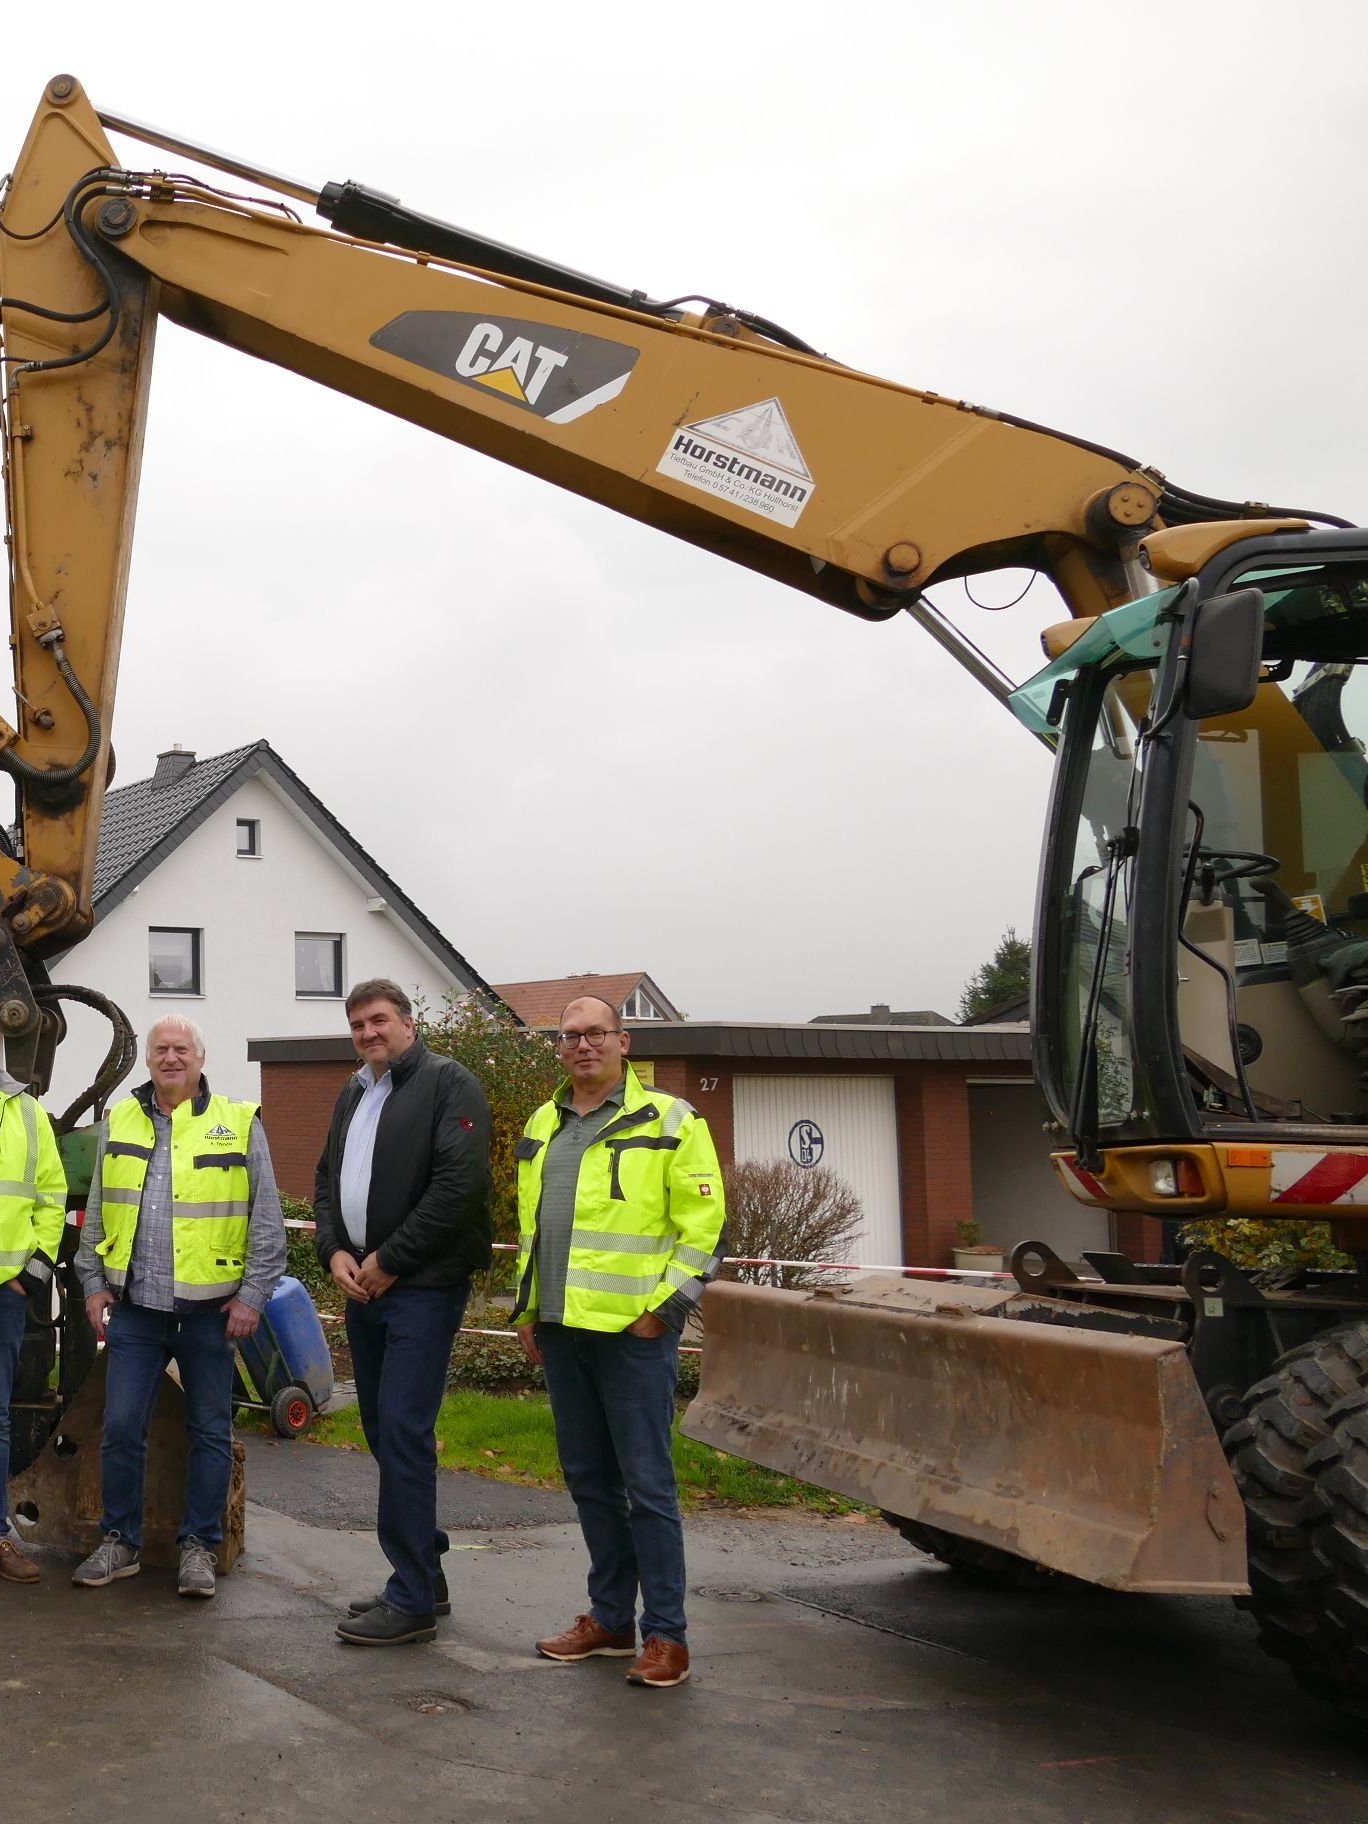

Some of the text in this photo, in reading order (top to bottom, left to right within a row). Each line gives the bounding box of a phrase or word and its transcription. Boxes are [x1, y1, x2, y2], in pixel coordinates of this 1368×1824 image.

[455, 322, 569, 405] CAT
[669, 452, 698, 470] Tiefbau
[698, 465, 725, 481] GmbH
[725, 476, 733, 485] &
[748, 485, 763, 497] KG
[763, 492, 799, 512] Hüllhorst
[673, 434, 807, 502] Horstmann
[683, 468, 711, 486] Telefon
[699, 1077, 719, 1092] 27
